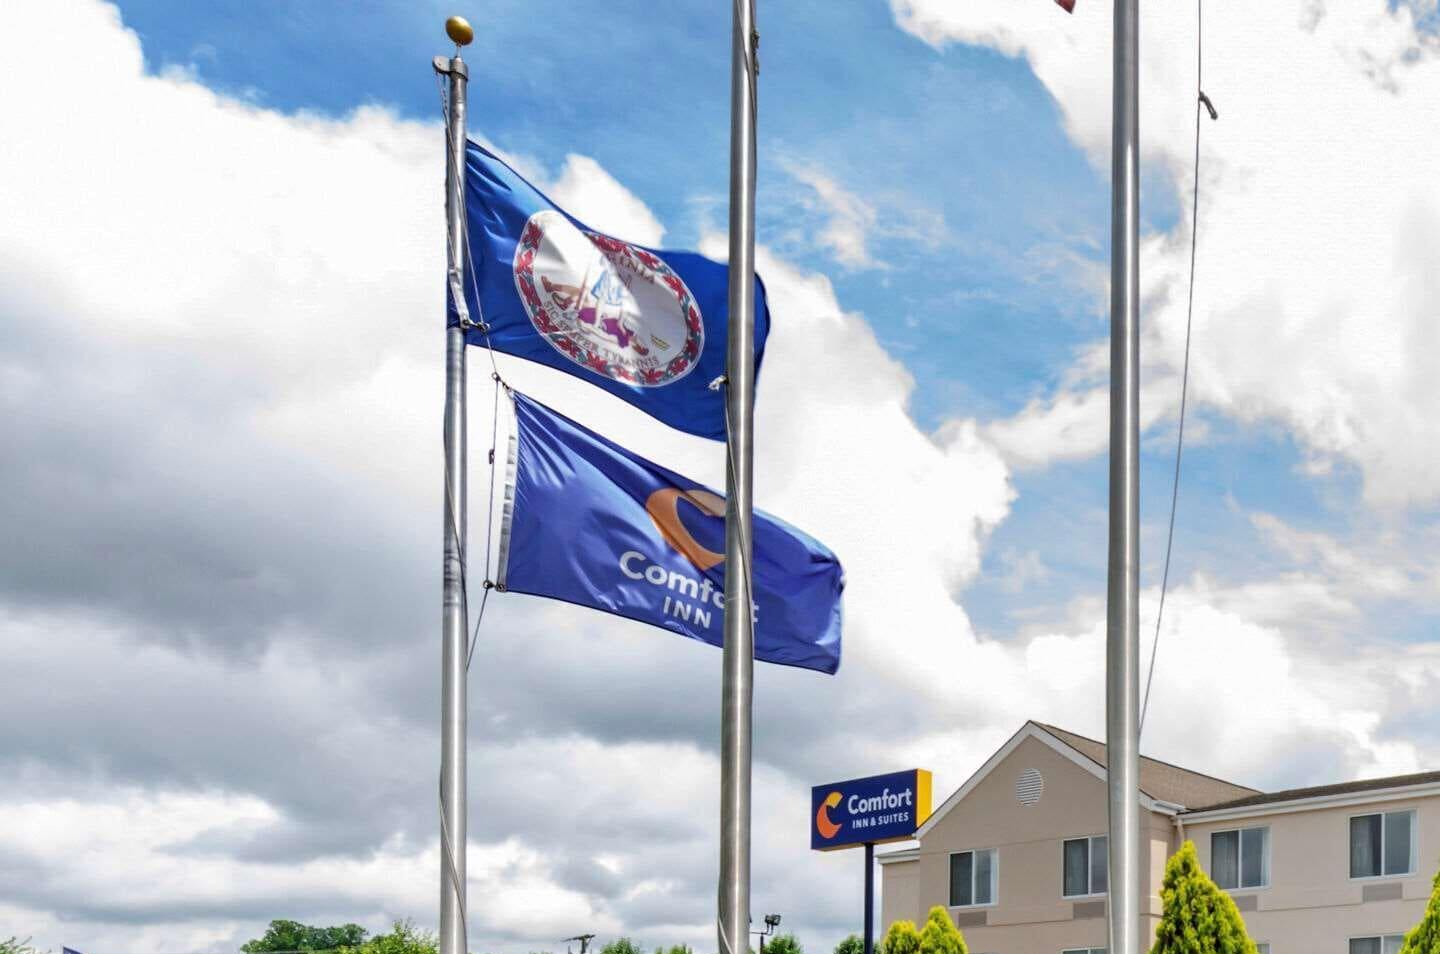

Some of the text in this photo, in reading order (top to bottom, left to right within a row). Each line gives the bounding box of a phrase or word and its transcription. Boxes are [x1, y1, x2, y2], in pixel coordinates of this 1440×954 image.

[663, 596, 712, 629] INN
[847, 788, 912, 814] Comfort
[852, 817, 869, 829] INN
[878, 812, 909, 825] SUITES
